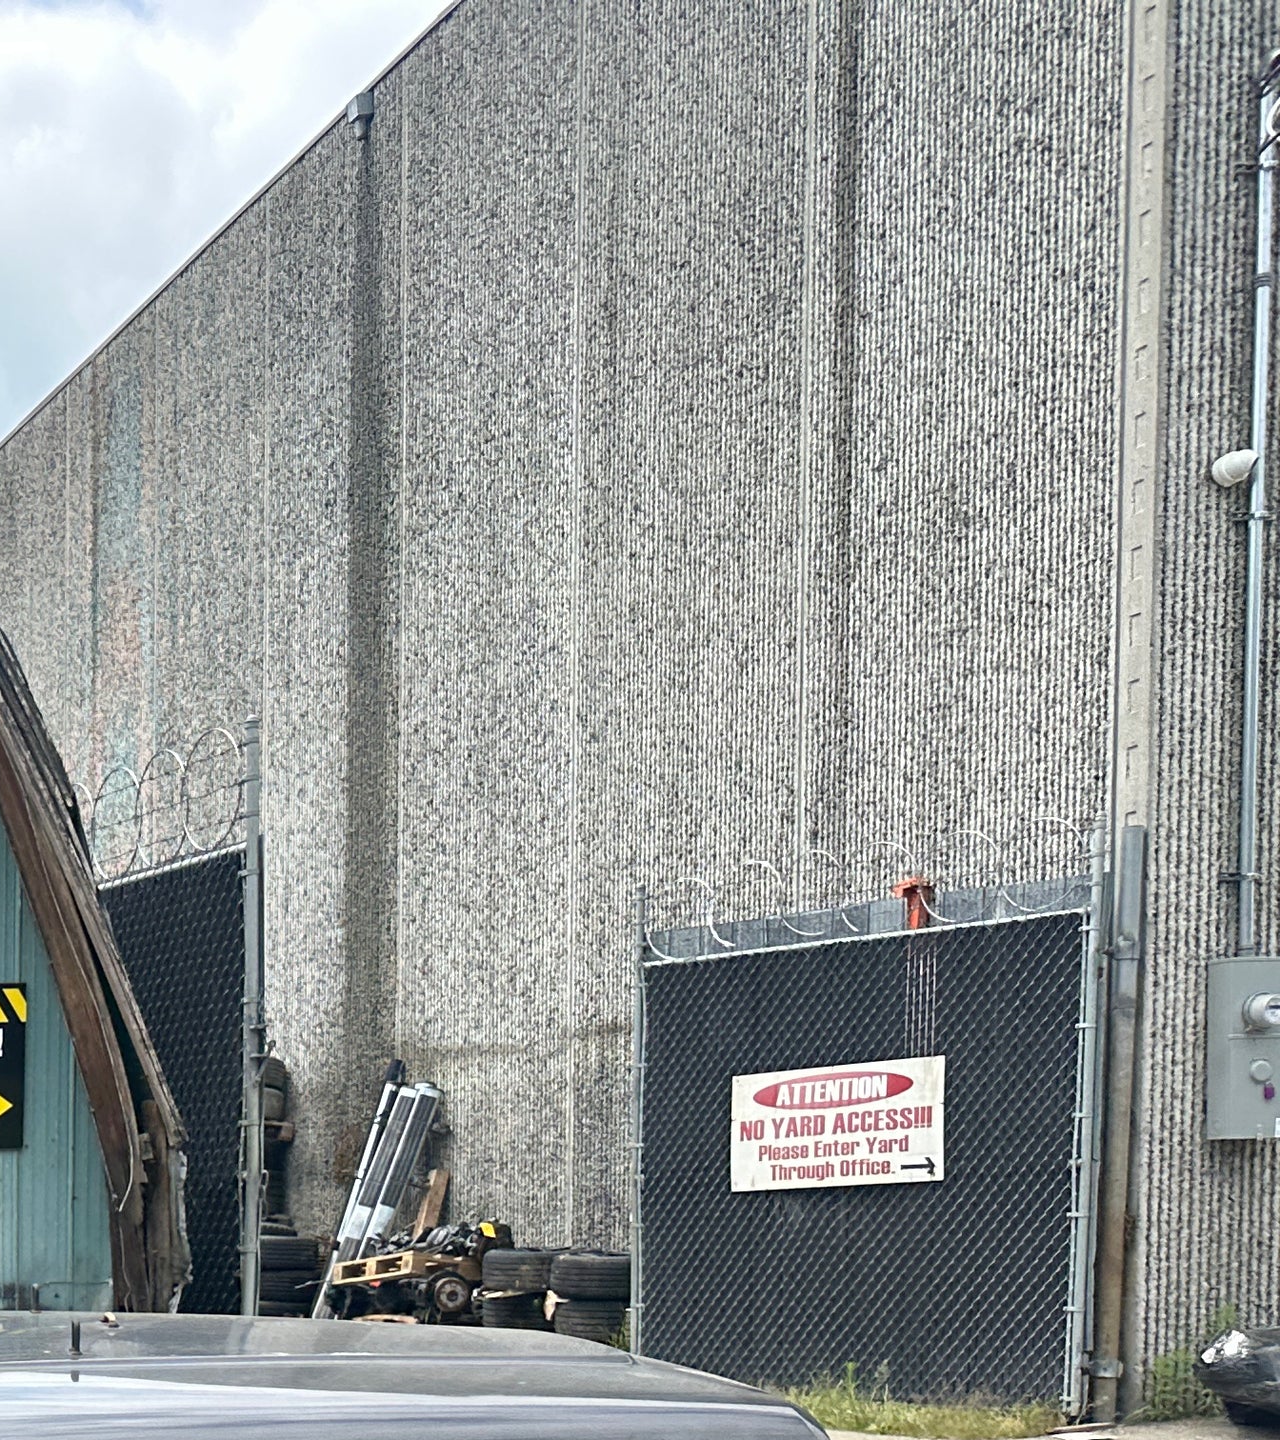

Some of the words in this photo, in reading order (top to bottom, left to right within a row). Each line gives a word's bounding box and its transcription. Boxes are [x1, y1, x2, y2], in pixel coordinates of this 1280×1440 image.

[776, 1075, 888, 1107] ATTENTION
[740, 1120, 765, 1141] NO
[771, 1115, 826, 1139] YARD
[832, 1106, 933, 1135] ACCESS!!!
[759, 1144, 809, 1161] Please
[814, 1140, 860, 1158] Enter
[866, 1135, 909, 1154] Yard
[770, 1163, 834, 1181] Through
[840, 1158, 896, 1177] Office.
